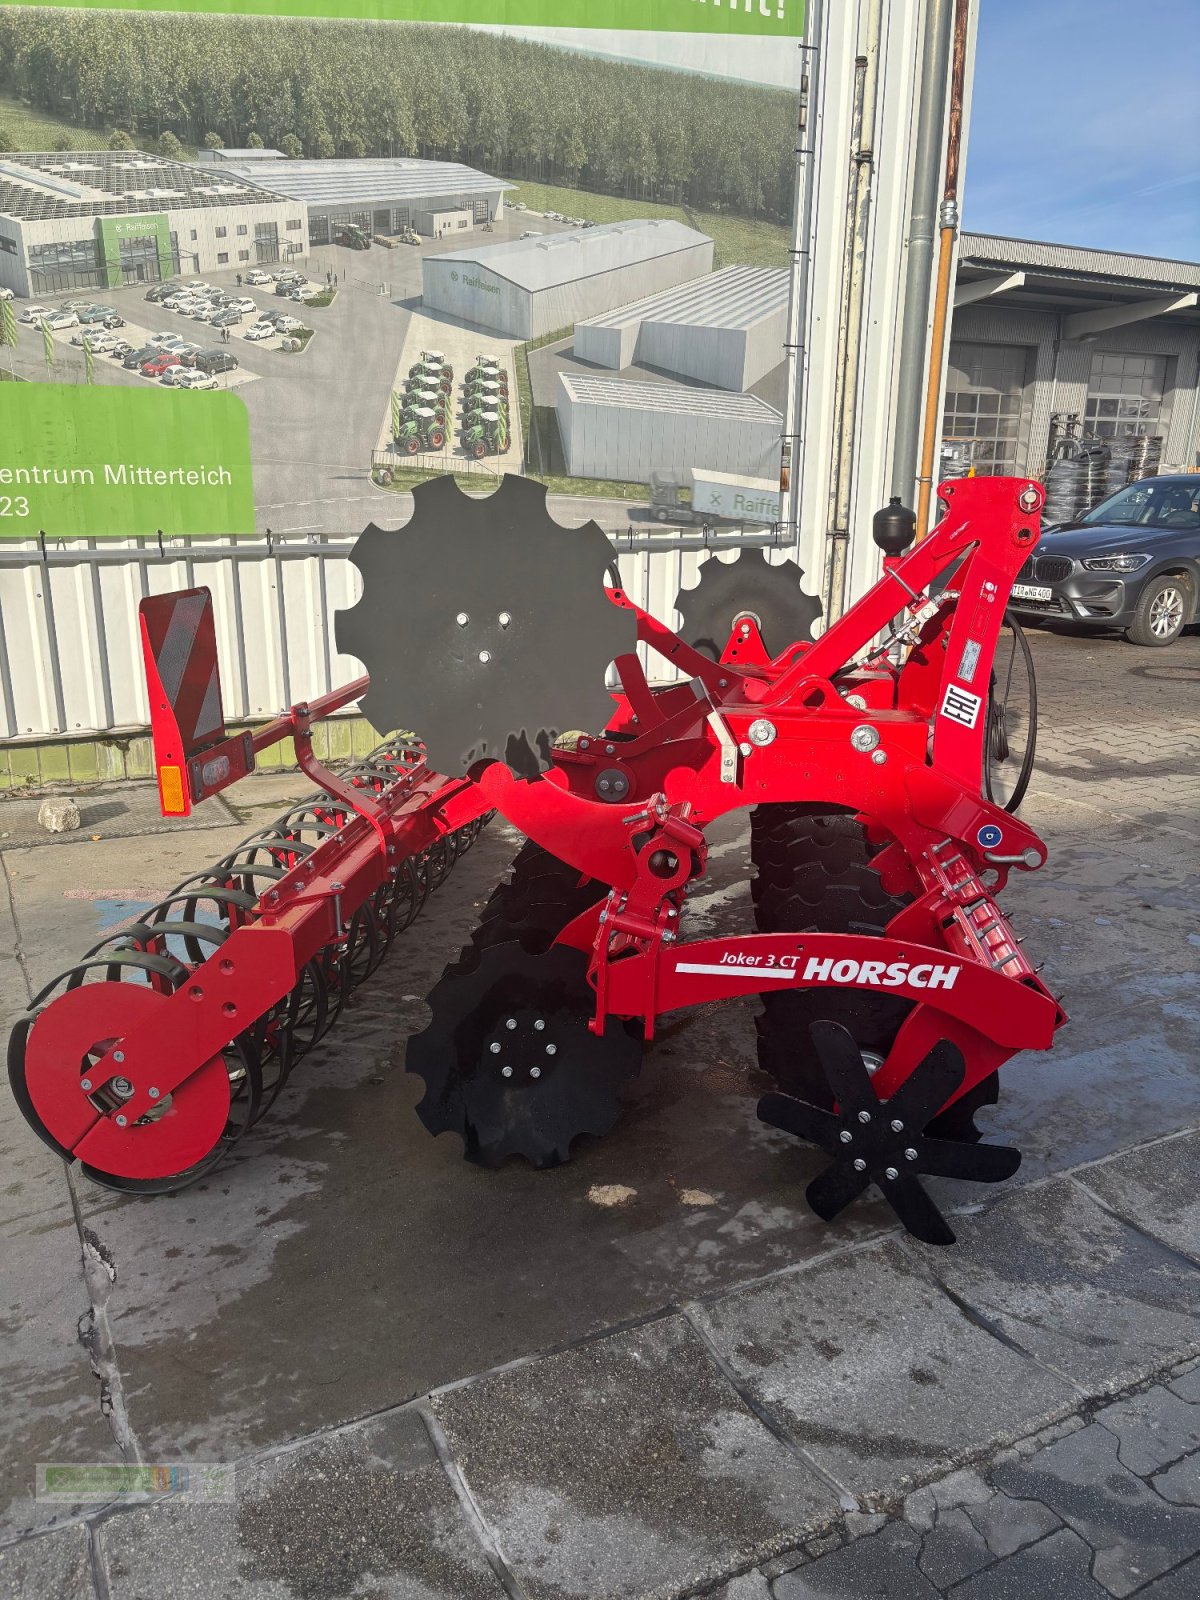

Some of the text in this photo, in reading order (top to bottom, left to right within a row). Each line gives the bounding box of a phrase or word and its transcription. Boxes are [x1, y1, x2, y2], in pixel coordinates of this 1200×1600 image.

[462, 274, 501, 295] Raiffeisen
[0, 464, 233, 486] entrum Mitterteich
[0, 496, 31, 517] 23
[719, 951, 961, 990] Joker 3 CT HORSCH
